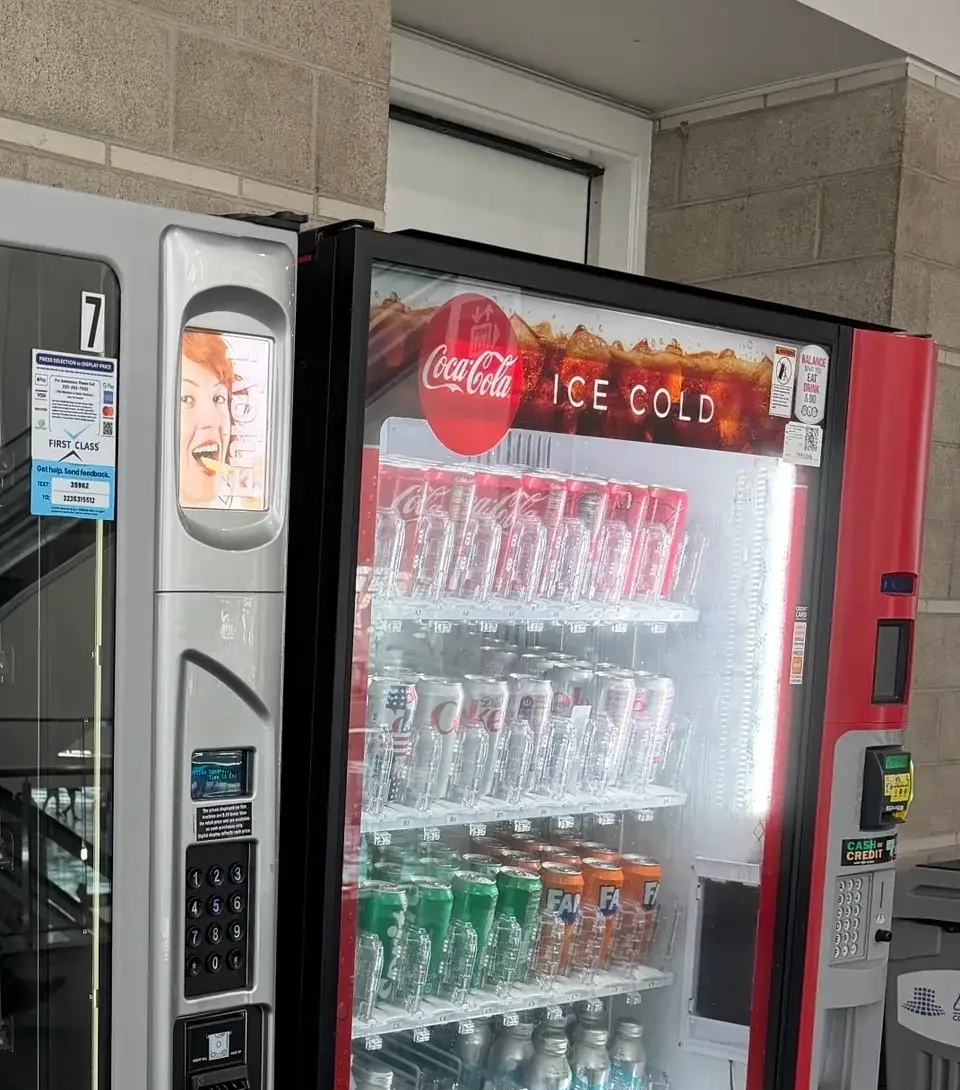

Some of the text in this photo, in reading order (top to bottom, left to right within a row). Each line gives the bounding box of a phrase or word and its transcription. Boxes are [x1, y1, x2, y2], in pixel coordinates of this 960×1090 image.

[85, 296, 103, 349] 7
[53, 358, 77, 367] SELECTION
[81, 361, 100, 369] DISPLAY
[801, 354, 827, 368] BALANCE
[421, 343, 520, 398] Coca-Cola
[806, 372, 818, 383] EAT
[803, 383, 820, 394] DRINK
[552, 372, 716, 424] ICE COLD
[809, 395, 817, 404] DO
[48, 439, 99, 452] FIRST CLASS
[80, 470, 111, 479] feedback.
[847, 840, 876, 851] CASH
[846, 849, 884, 860] CREDIT
[193, 871, 198, 885] 1
[213, 869, 220, 883] 2
[234, 867, 241, 881] 3
[191, 900, 197, 915] 4
[212, 899, 219, 913] 5
[233, 896, 241, 910] 6
[192, 930, 198, 944] 7
[212, 927, 219, 941] 8
[233, 924, 240, 938] 9
[212, 956, 218, 970] 0
